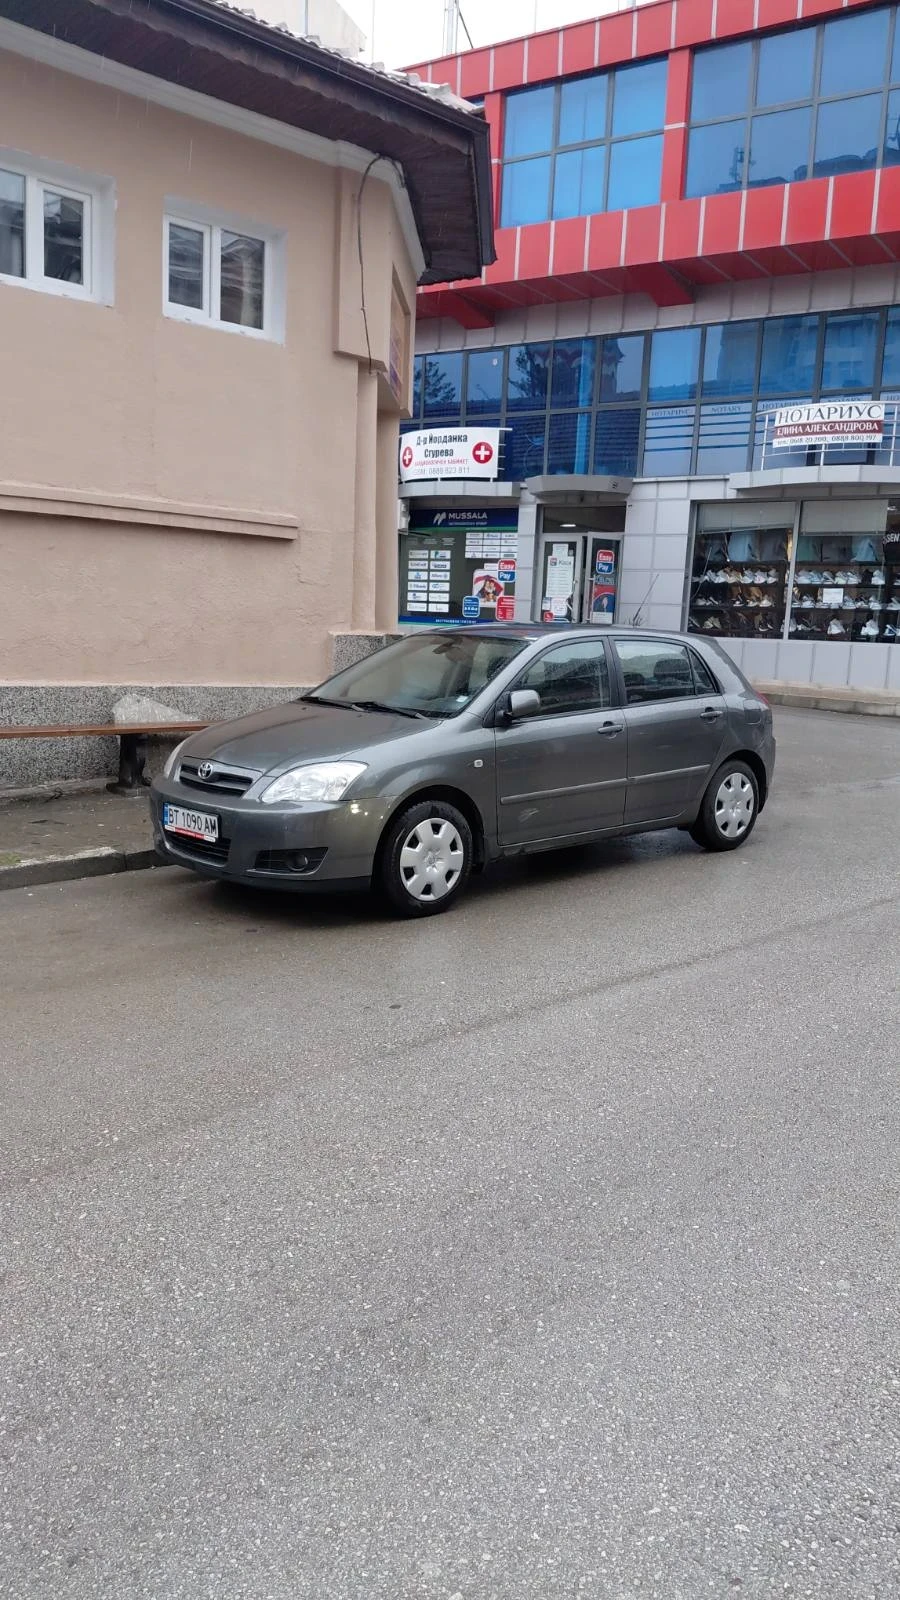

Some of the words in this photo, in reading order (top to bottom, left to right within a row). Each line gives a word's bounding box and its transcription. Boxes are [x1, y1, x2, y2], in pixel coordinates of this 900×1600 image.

[711, 405, 741, 413] NOTARY
[778, 404, 882, 424] НОТАРИУС
[777, 427, 803, 436] ЕЛИНА
[804, 421, 879, 433] АЛЕКСАНДРОВА
[429, 433, 468, 445] Йорданка
[424, 448, 454, 458] Сгурева
[448, 511, 488, 520] MUSSALA
[599, 553, 612, 562] Easy
[500, 562, 515, 570] Easy
[598, 563, 609, 572] Pay
[499, 571, 512, 580] Pay
[169, 807, 179, 825] BT
[182, 811, 203, 831] 1090
[204, 816, 217, 835] AM
